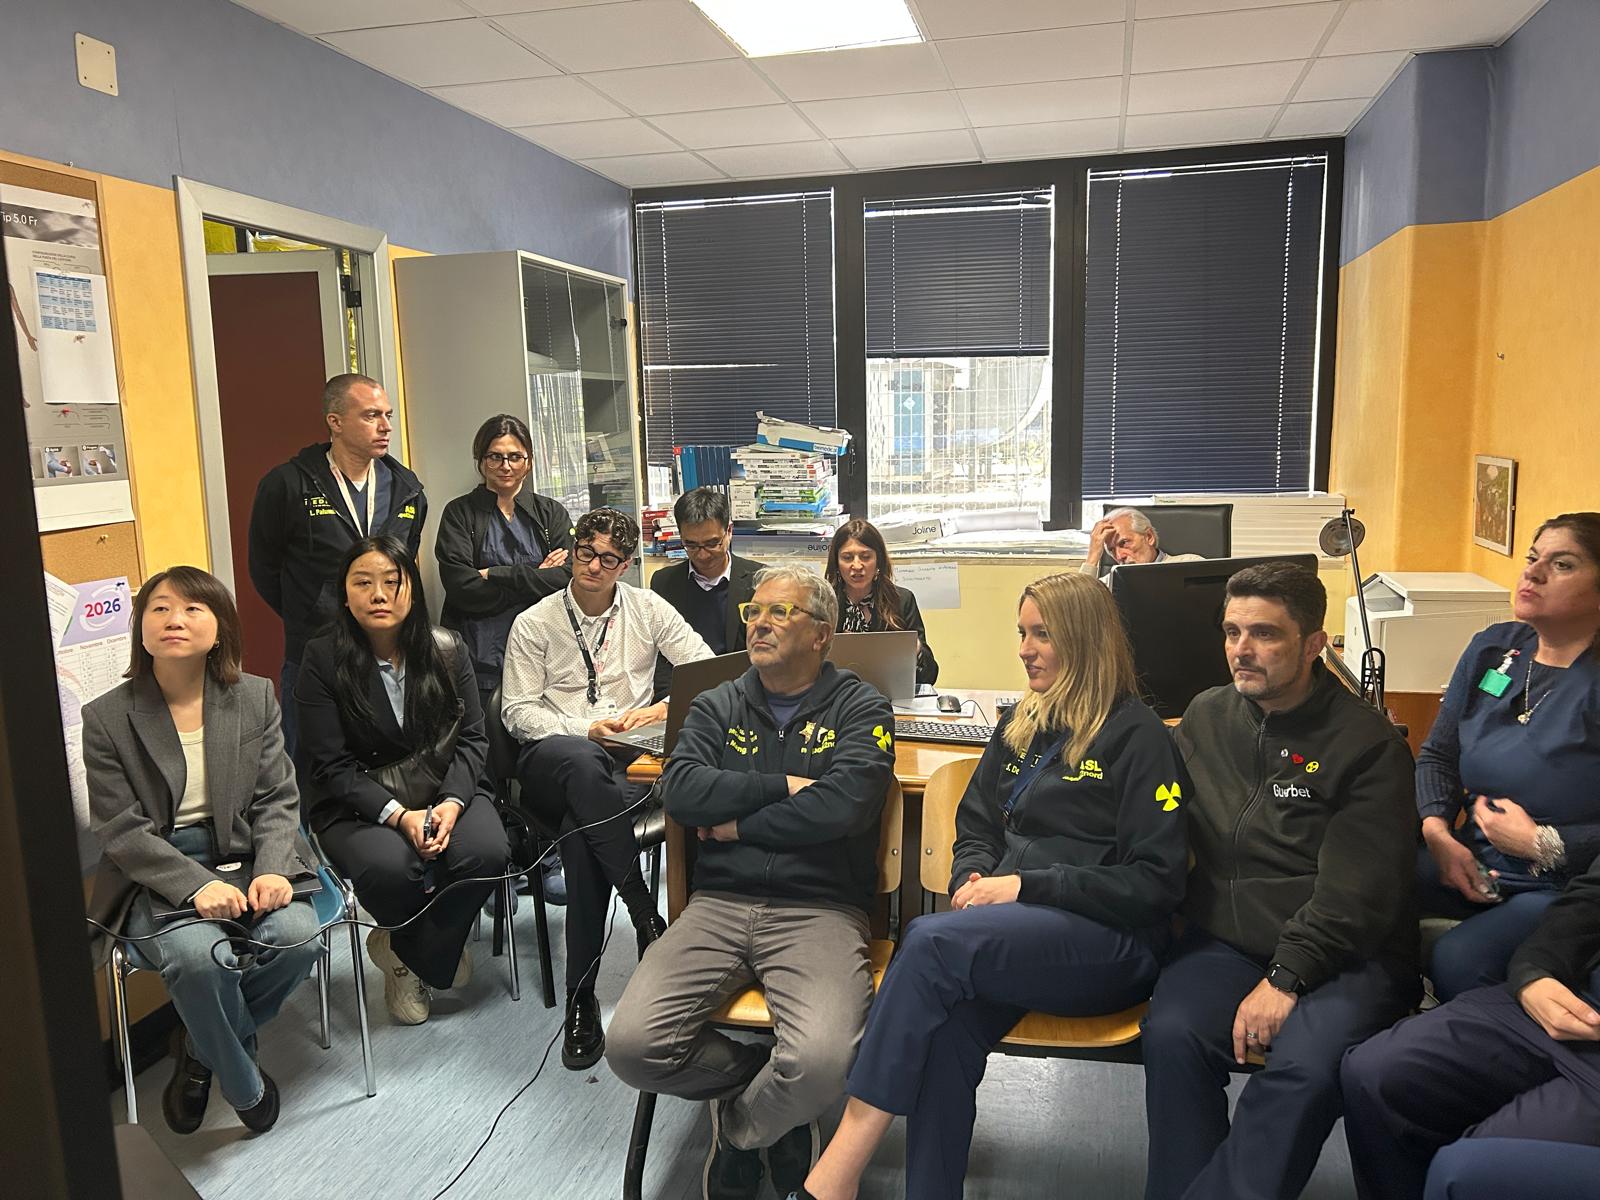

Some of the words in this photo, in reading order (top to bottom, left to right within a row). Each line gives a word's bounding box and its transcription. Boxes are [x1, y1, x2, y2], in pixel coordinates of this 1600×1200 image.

[12, 213, 27, 225] 5.0
[28, 216, 38, 227] Fr
[912, 525, 937, 536] Joline
[84, 598, 121, 618] 2026
